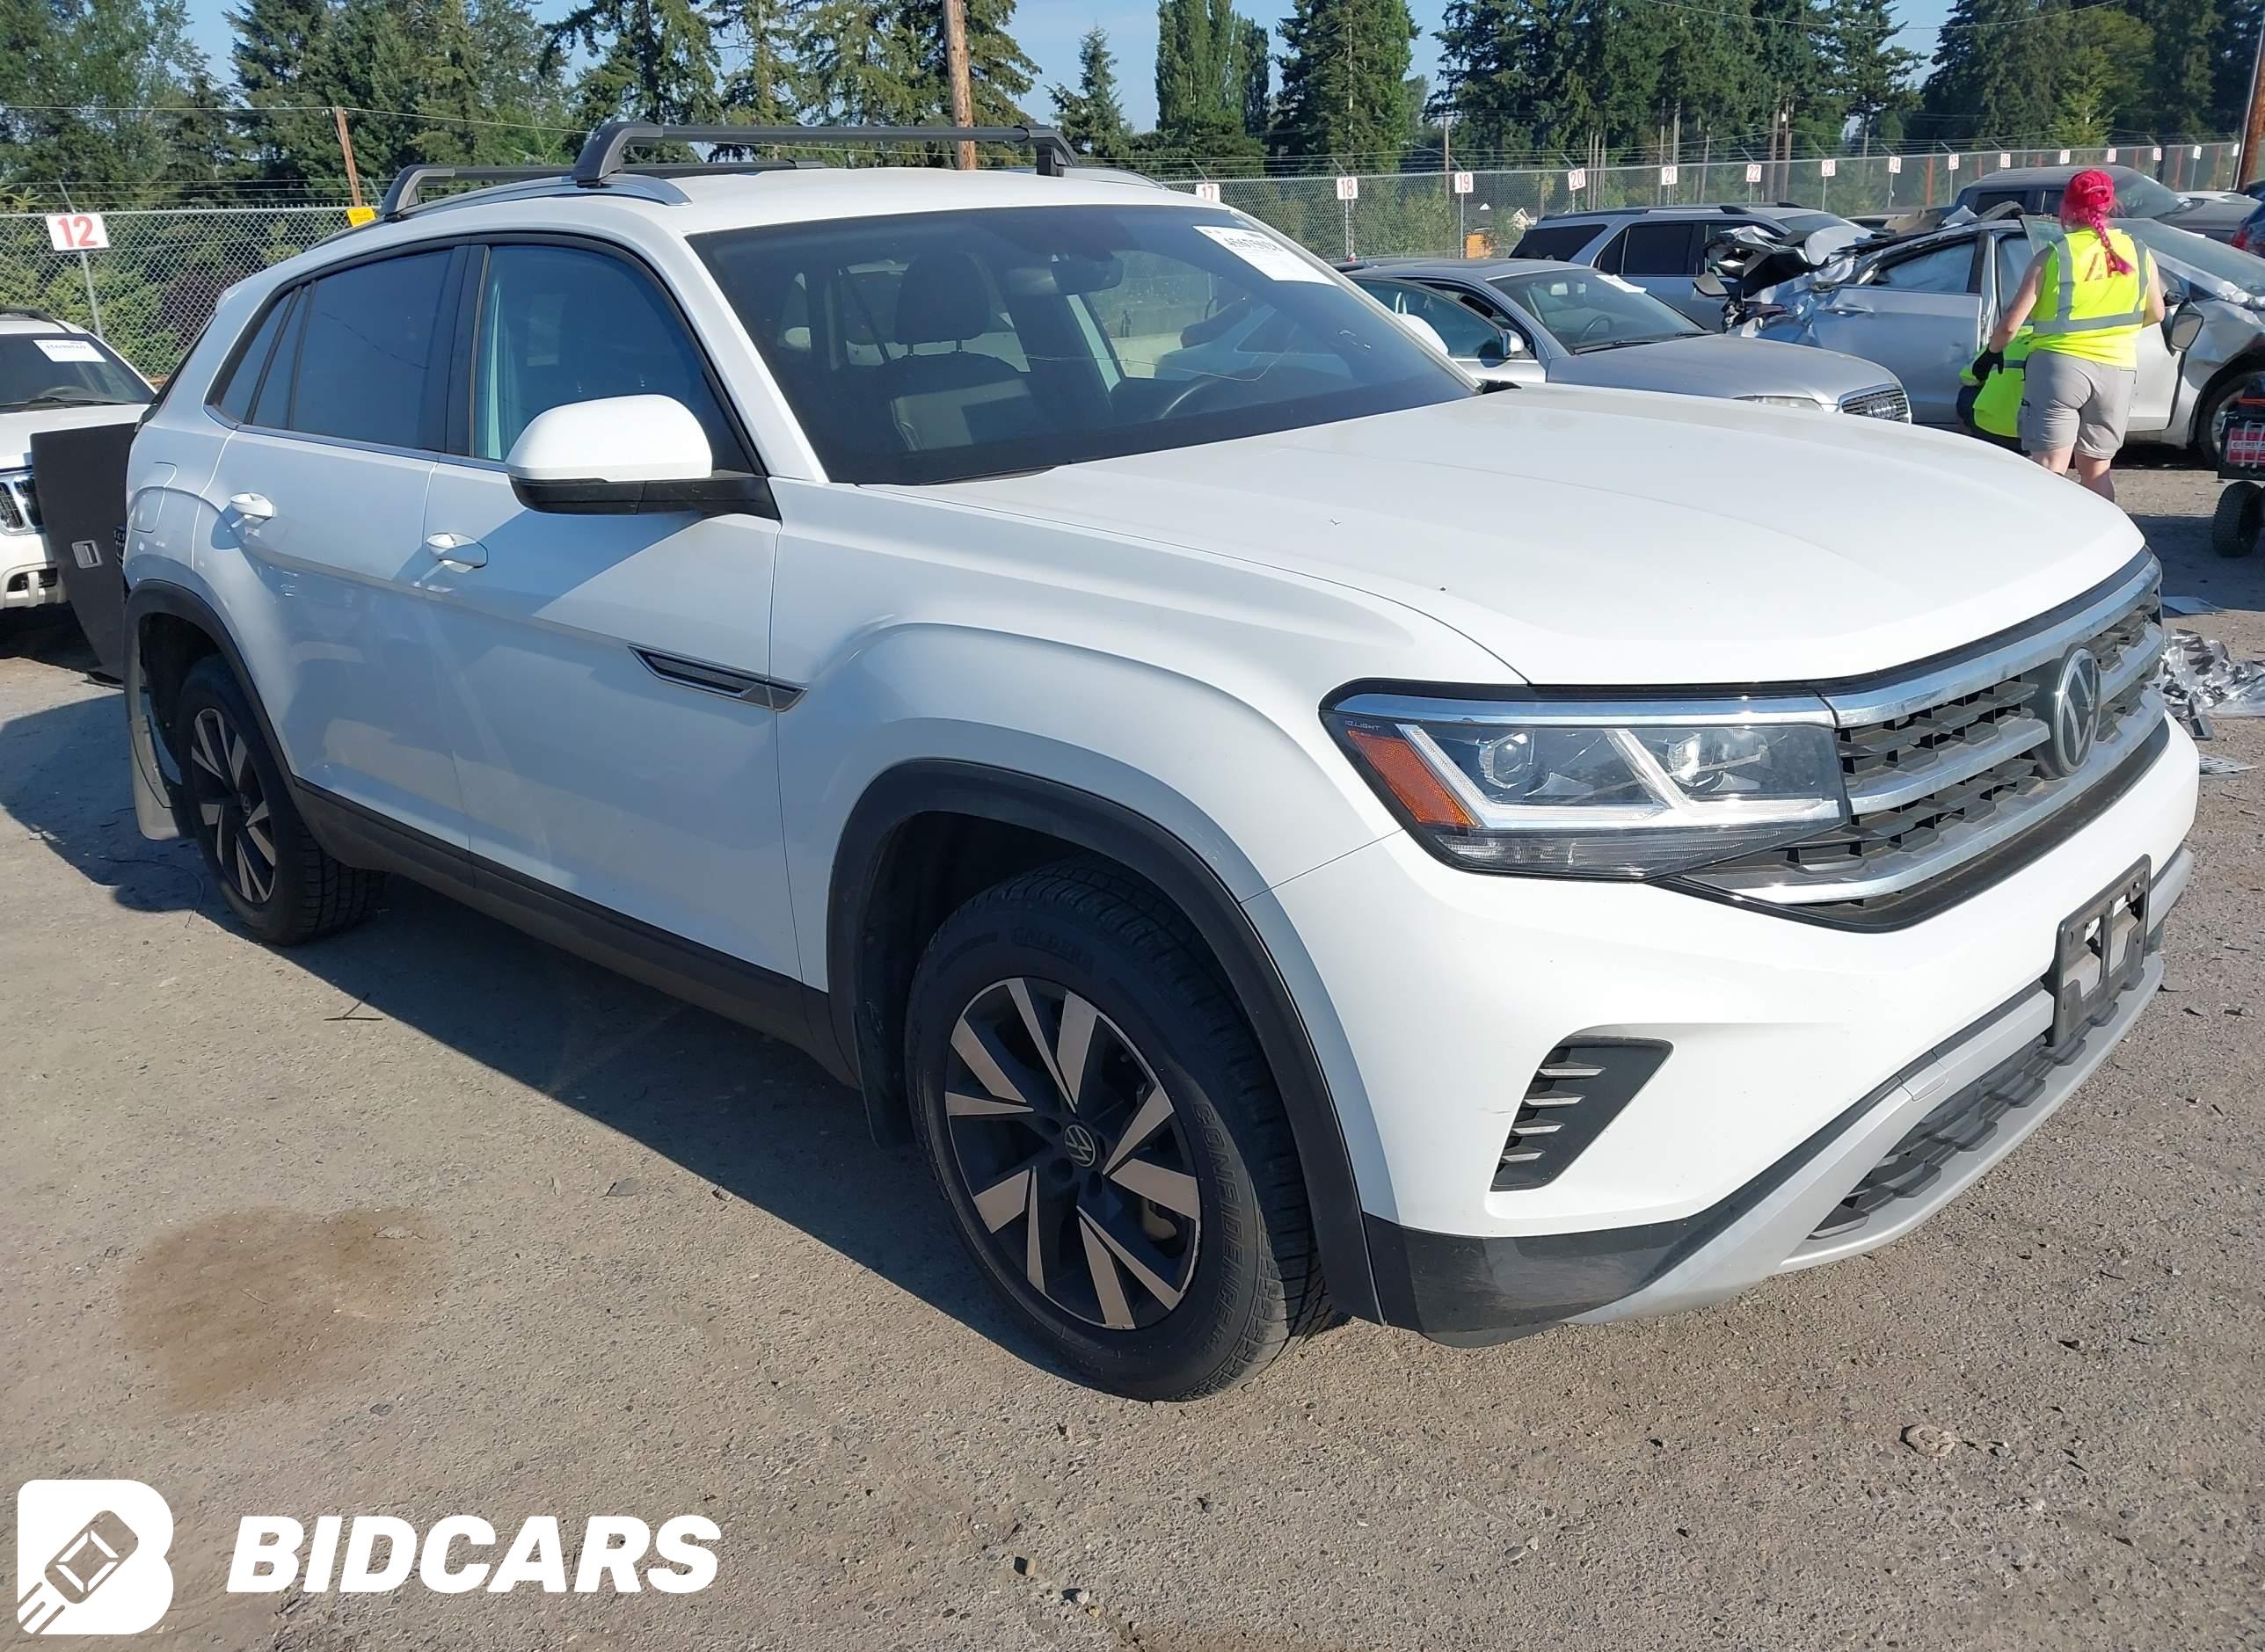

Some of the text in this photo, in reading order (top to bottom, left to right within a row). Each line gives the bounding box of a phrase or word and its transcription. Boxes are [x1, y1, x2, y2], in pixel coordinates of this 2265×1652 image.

[1748, 165, 1759, 180] 22
[1824, 161, 1833, 175] 23
[1890, 158, 1899, 171] 24
[1459, 174, 1469, 191] 19
[1570, 171, 1584, 188] 20
[1664, 168, 1674, 183] 21
[1201, 185, 1214, 200] 17
[1341, 178, 1354, 197] 18
[57, 215, 98, 248] 12
[1191, 1103, 1244, 1325] CONFIDENCE
